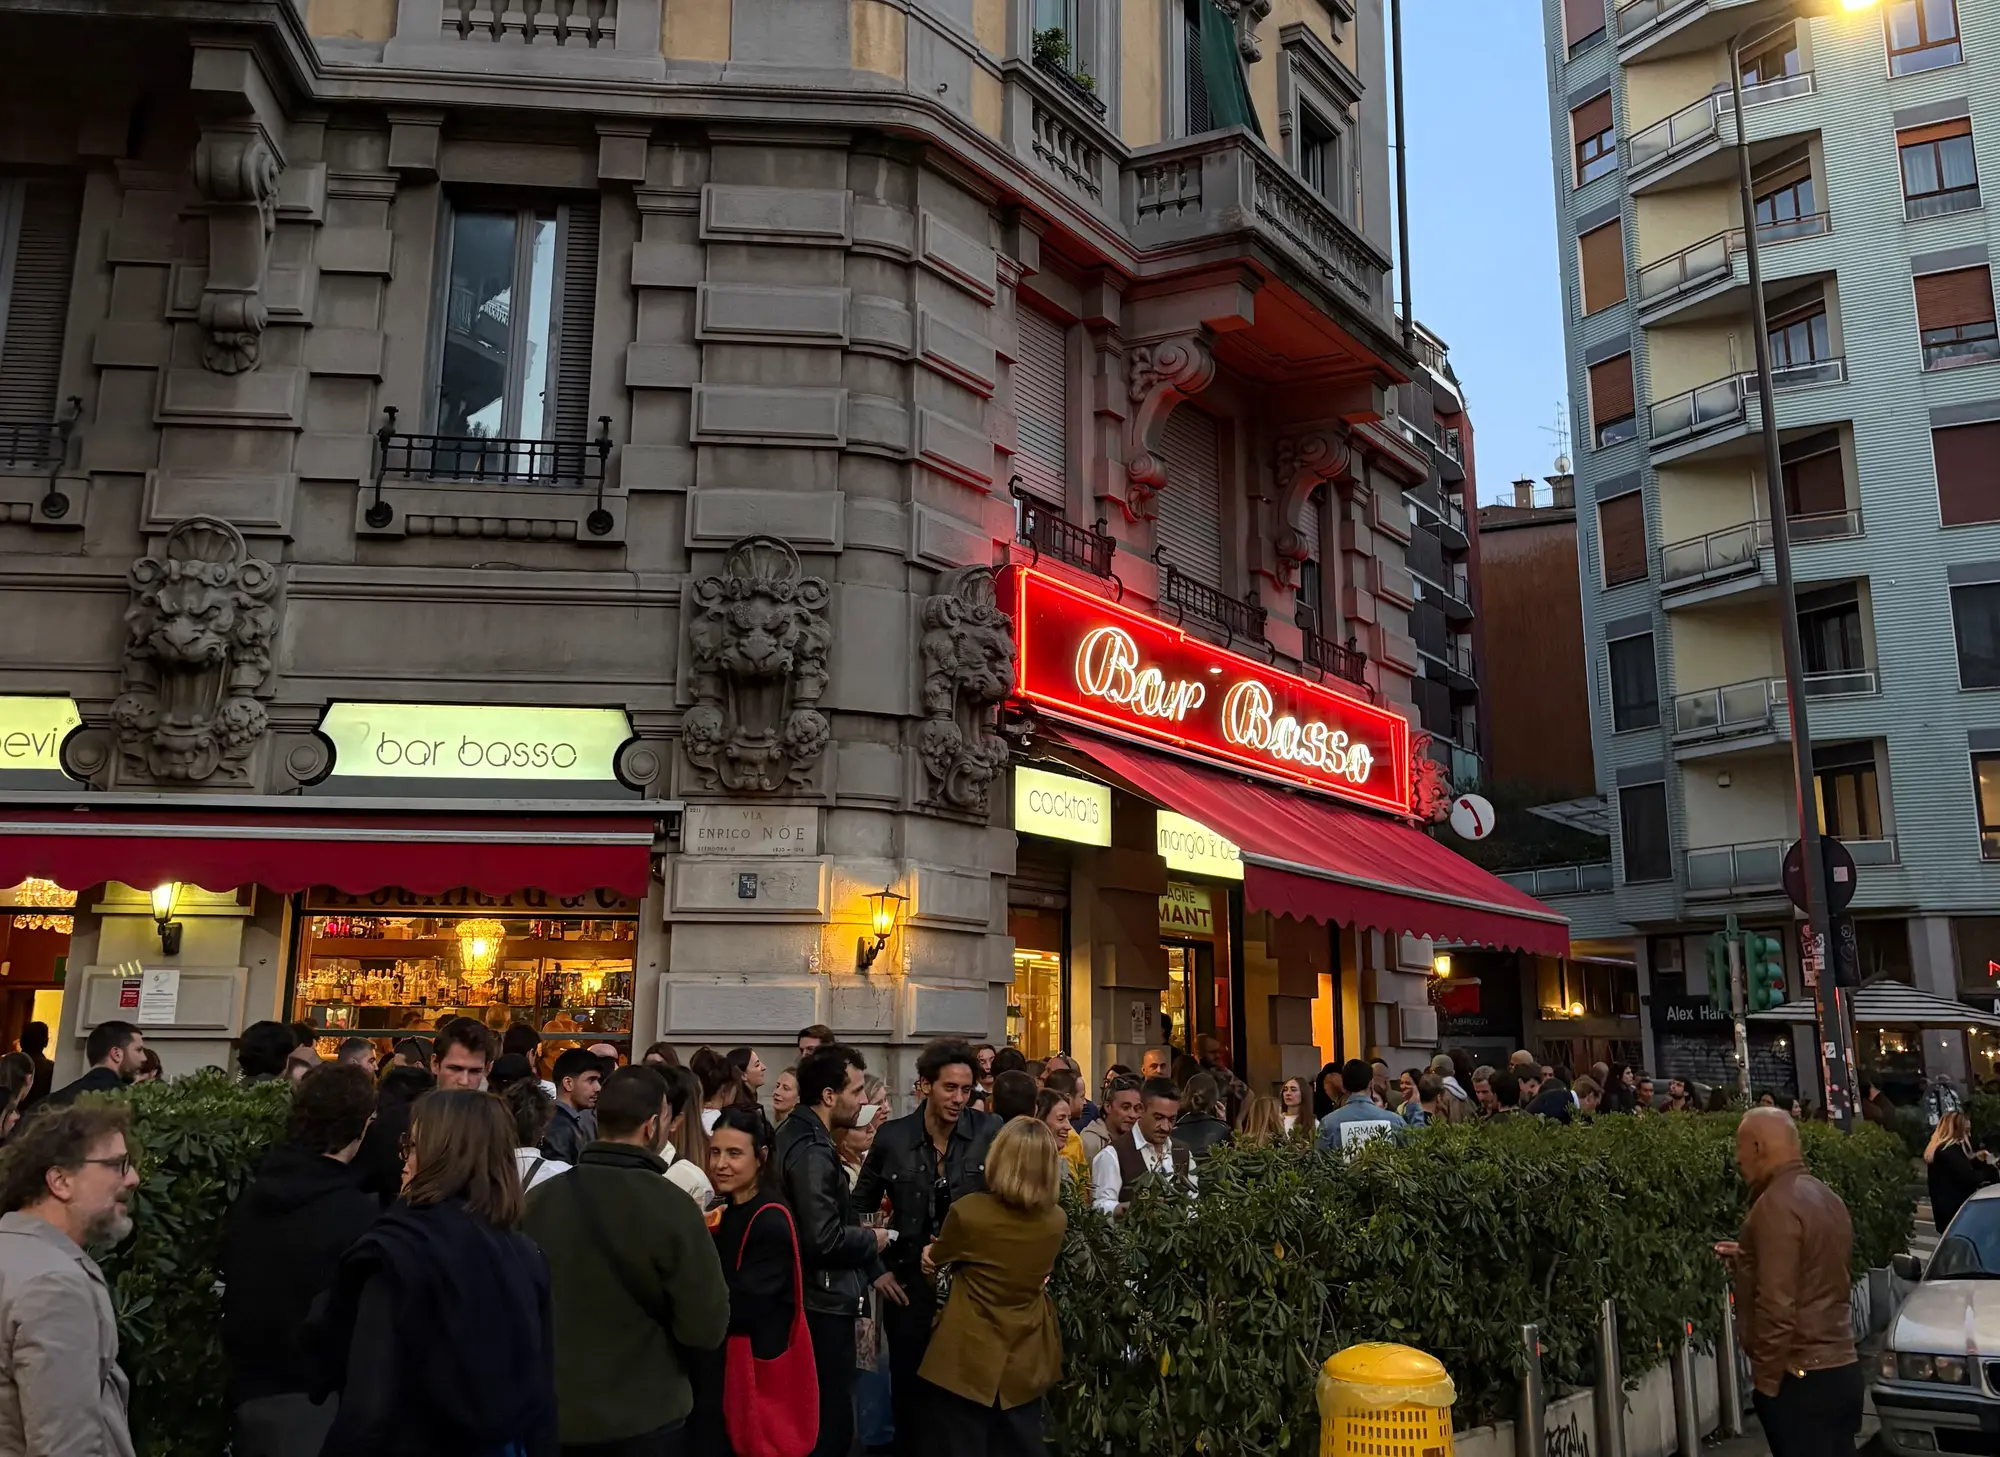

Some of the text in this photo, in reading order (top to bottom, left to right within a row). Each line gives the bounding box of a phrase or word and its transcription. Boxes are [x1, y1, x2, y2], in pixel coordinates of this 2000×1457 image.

[1076, 626, 1374, 783] Bar Basso
[0, 727, 58, 757] evi
[376, 732, 577, 768] bar basso
[743, 811, 763, 820] VIA
[1029, 790, 1099, 824] cocktails
[698, 824, 805, 840] ENRICO NÖE
[1160, 829, 1205, 860] mangia
[1160, 887, 1196, 904] AGNE
[1666, 1005, 1694, 1021] Alex
